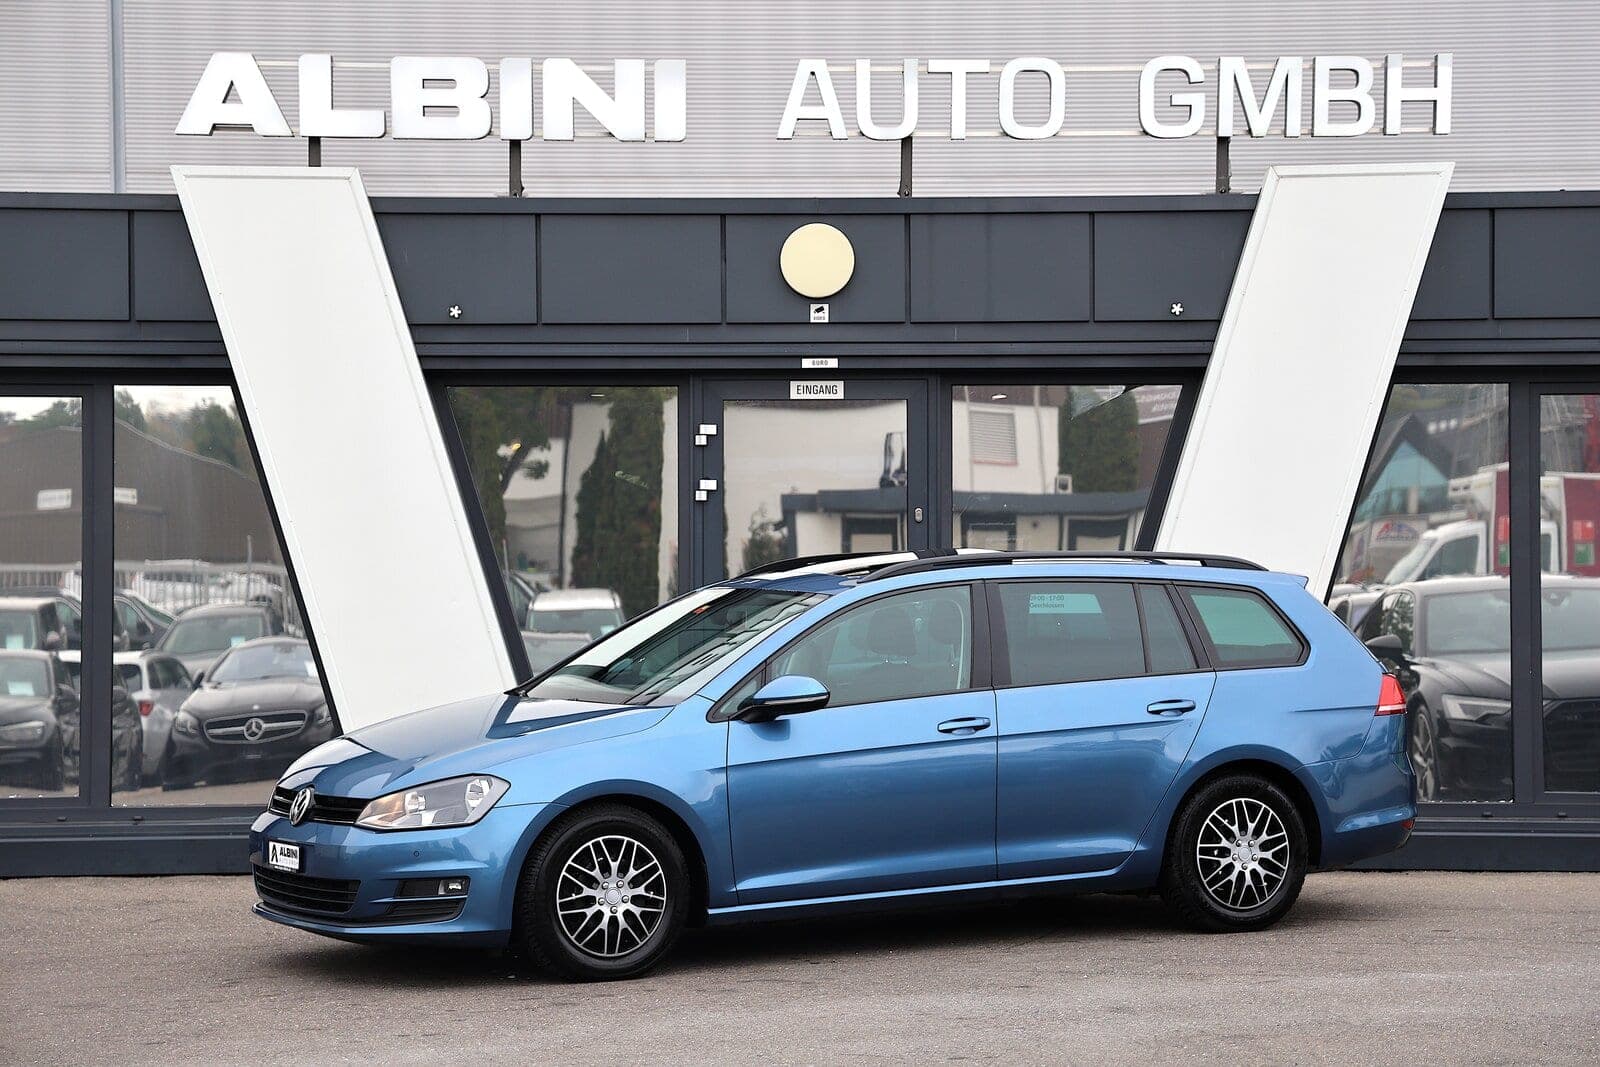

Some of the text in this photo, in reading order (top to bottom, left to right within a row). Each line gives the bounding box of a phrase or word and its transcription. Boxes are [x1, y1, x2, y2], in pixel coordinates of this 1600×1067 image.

[174, 52, 1453, 142] ALBINI AUTO GMBH
[796, 384, 839, 396] EINGANG
[279, 847, 298, 859] ALBINI
